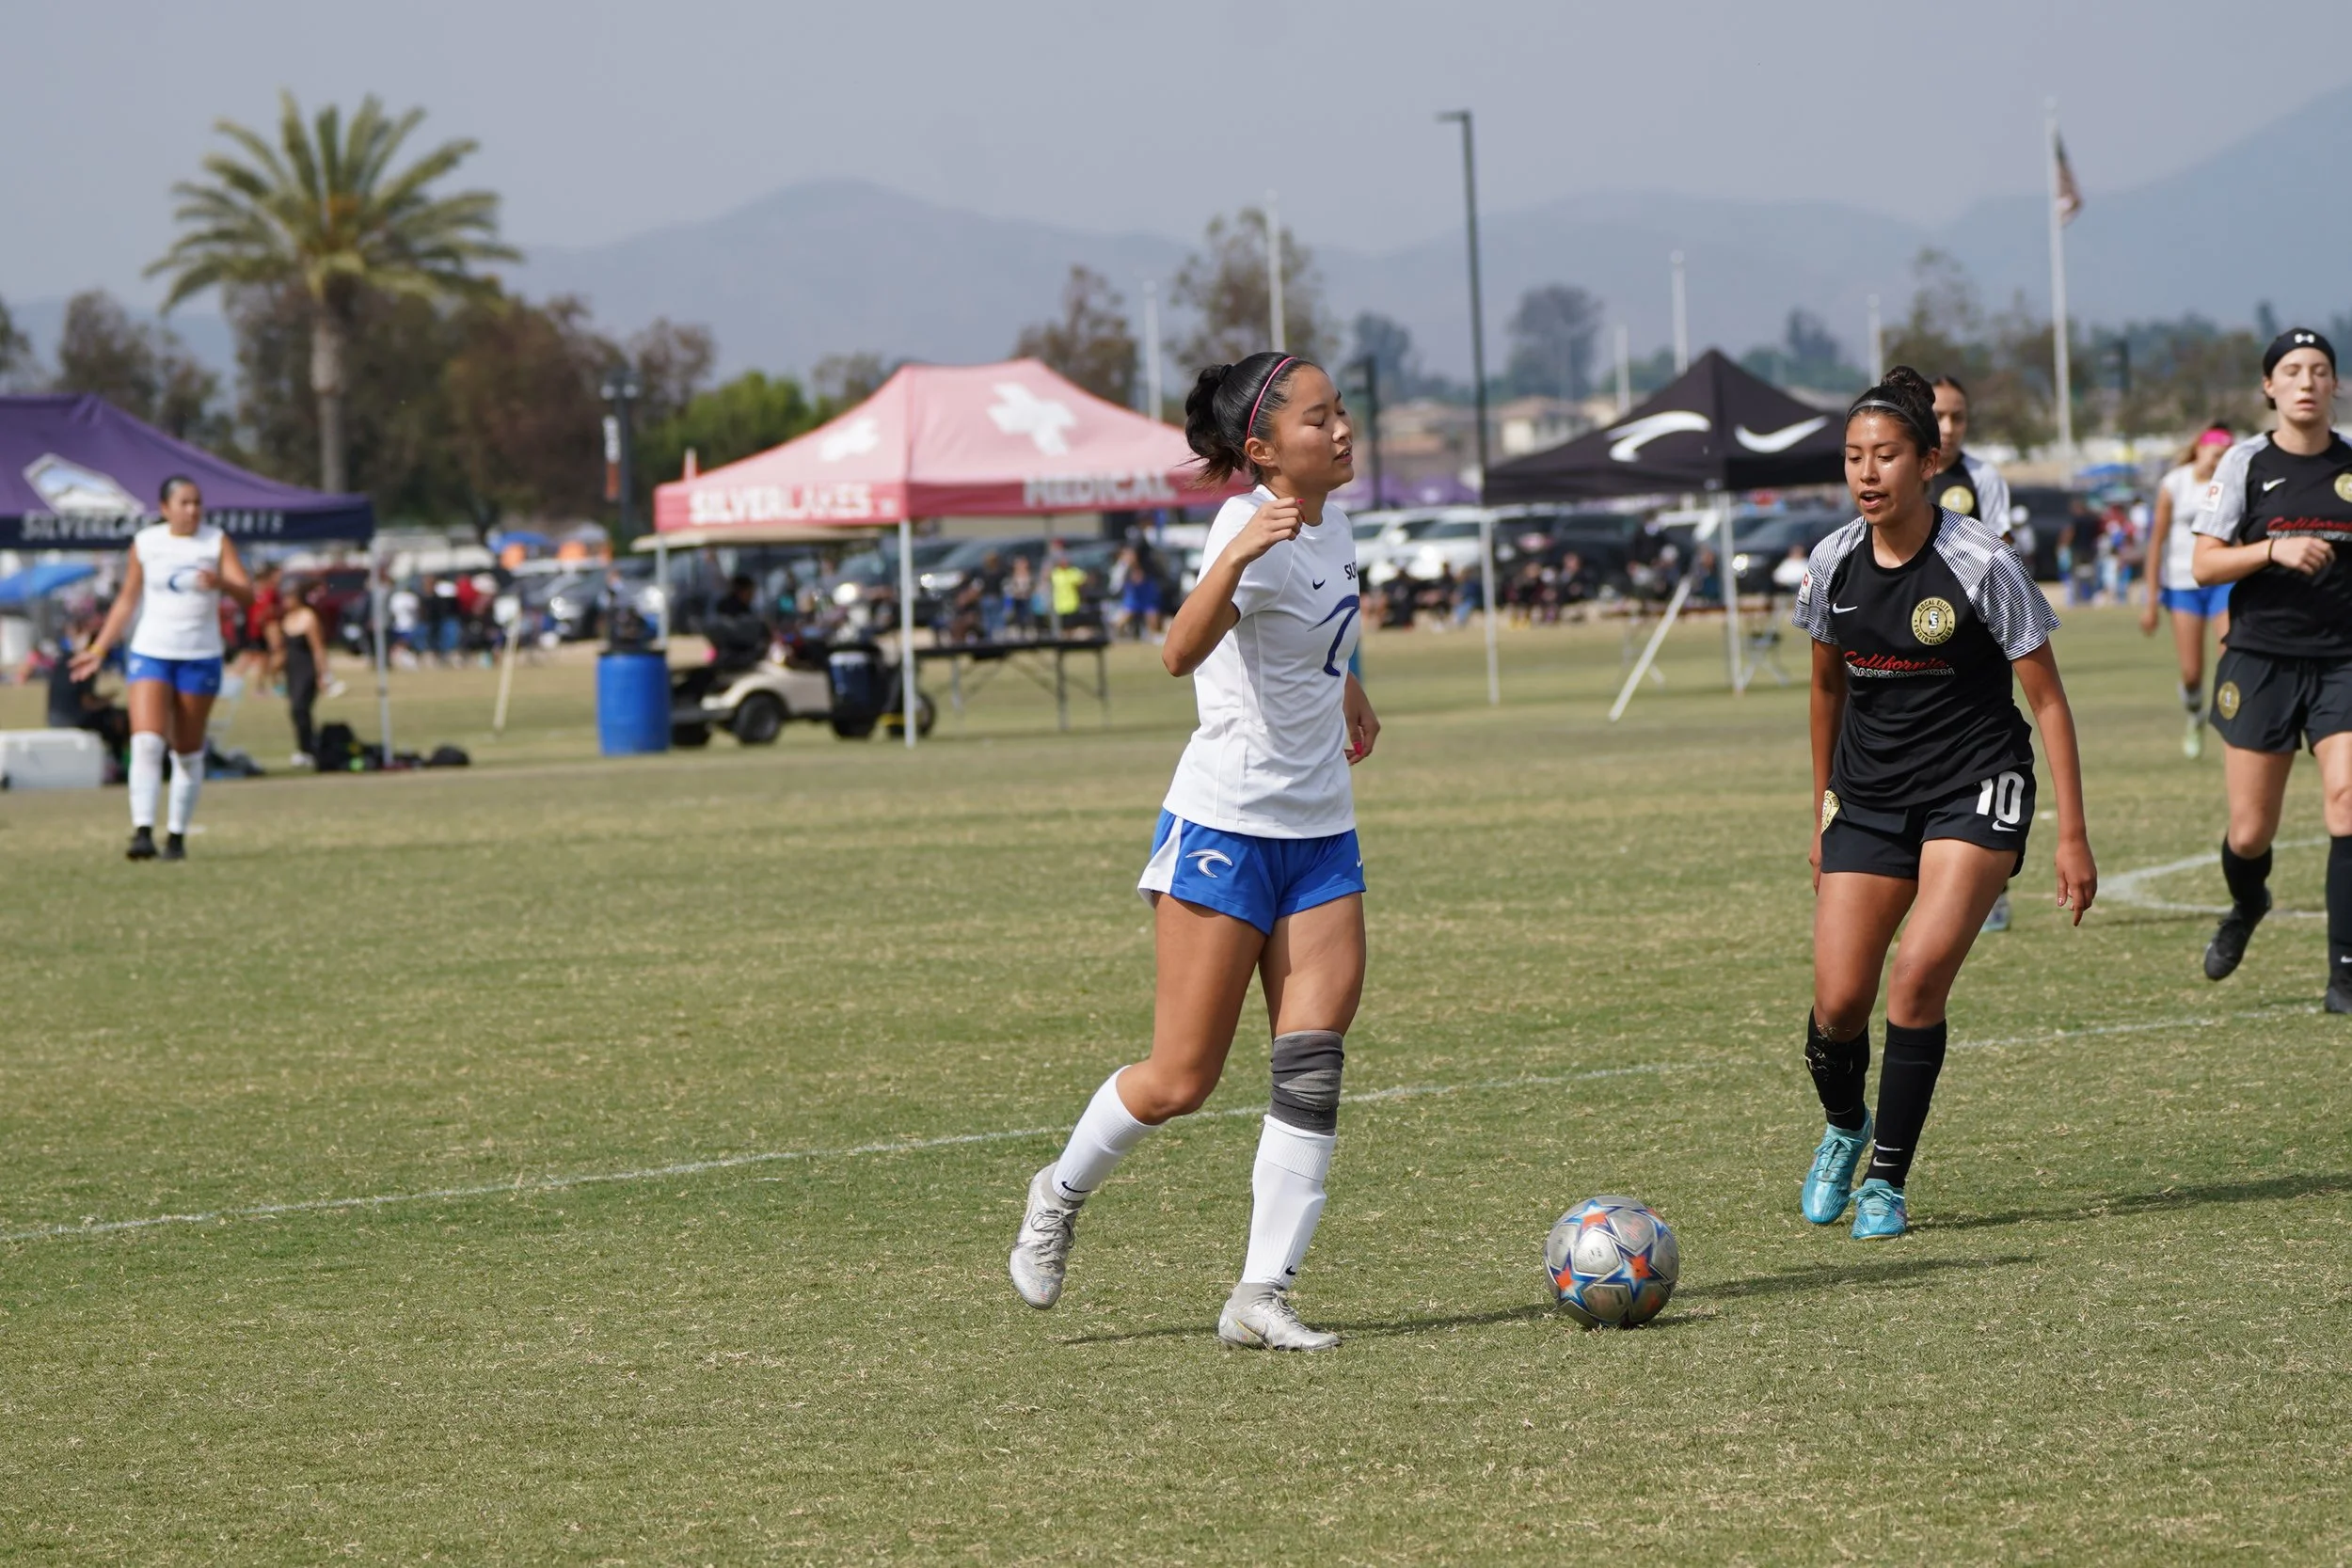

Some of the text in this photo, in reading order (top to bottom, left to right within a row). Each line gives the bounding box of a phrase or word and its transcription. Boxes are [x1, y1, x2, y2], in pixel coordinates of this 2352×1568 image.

[689, 482, 874, 525] SILVERLAKES
[1023, 470, 1176, 508] MEDICAL
[1916, 599, 1951, 613] SOCAL ELITE
[1844, 650, 1949, 672] California
[1977, 770, 2025, 824] 10
